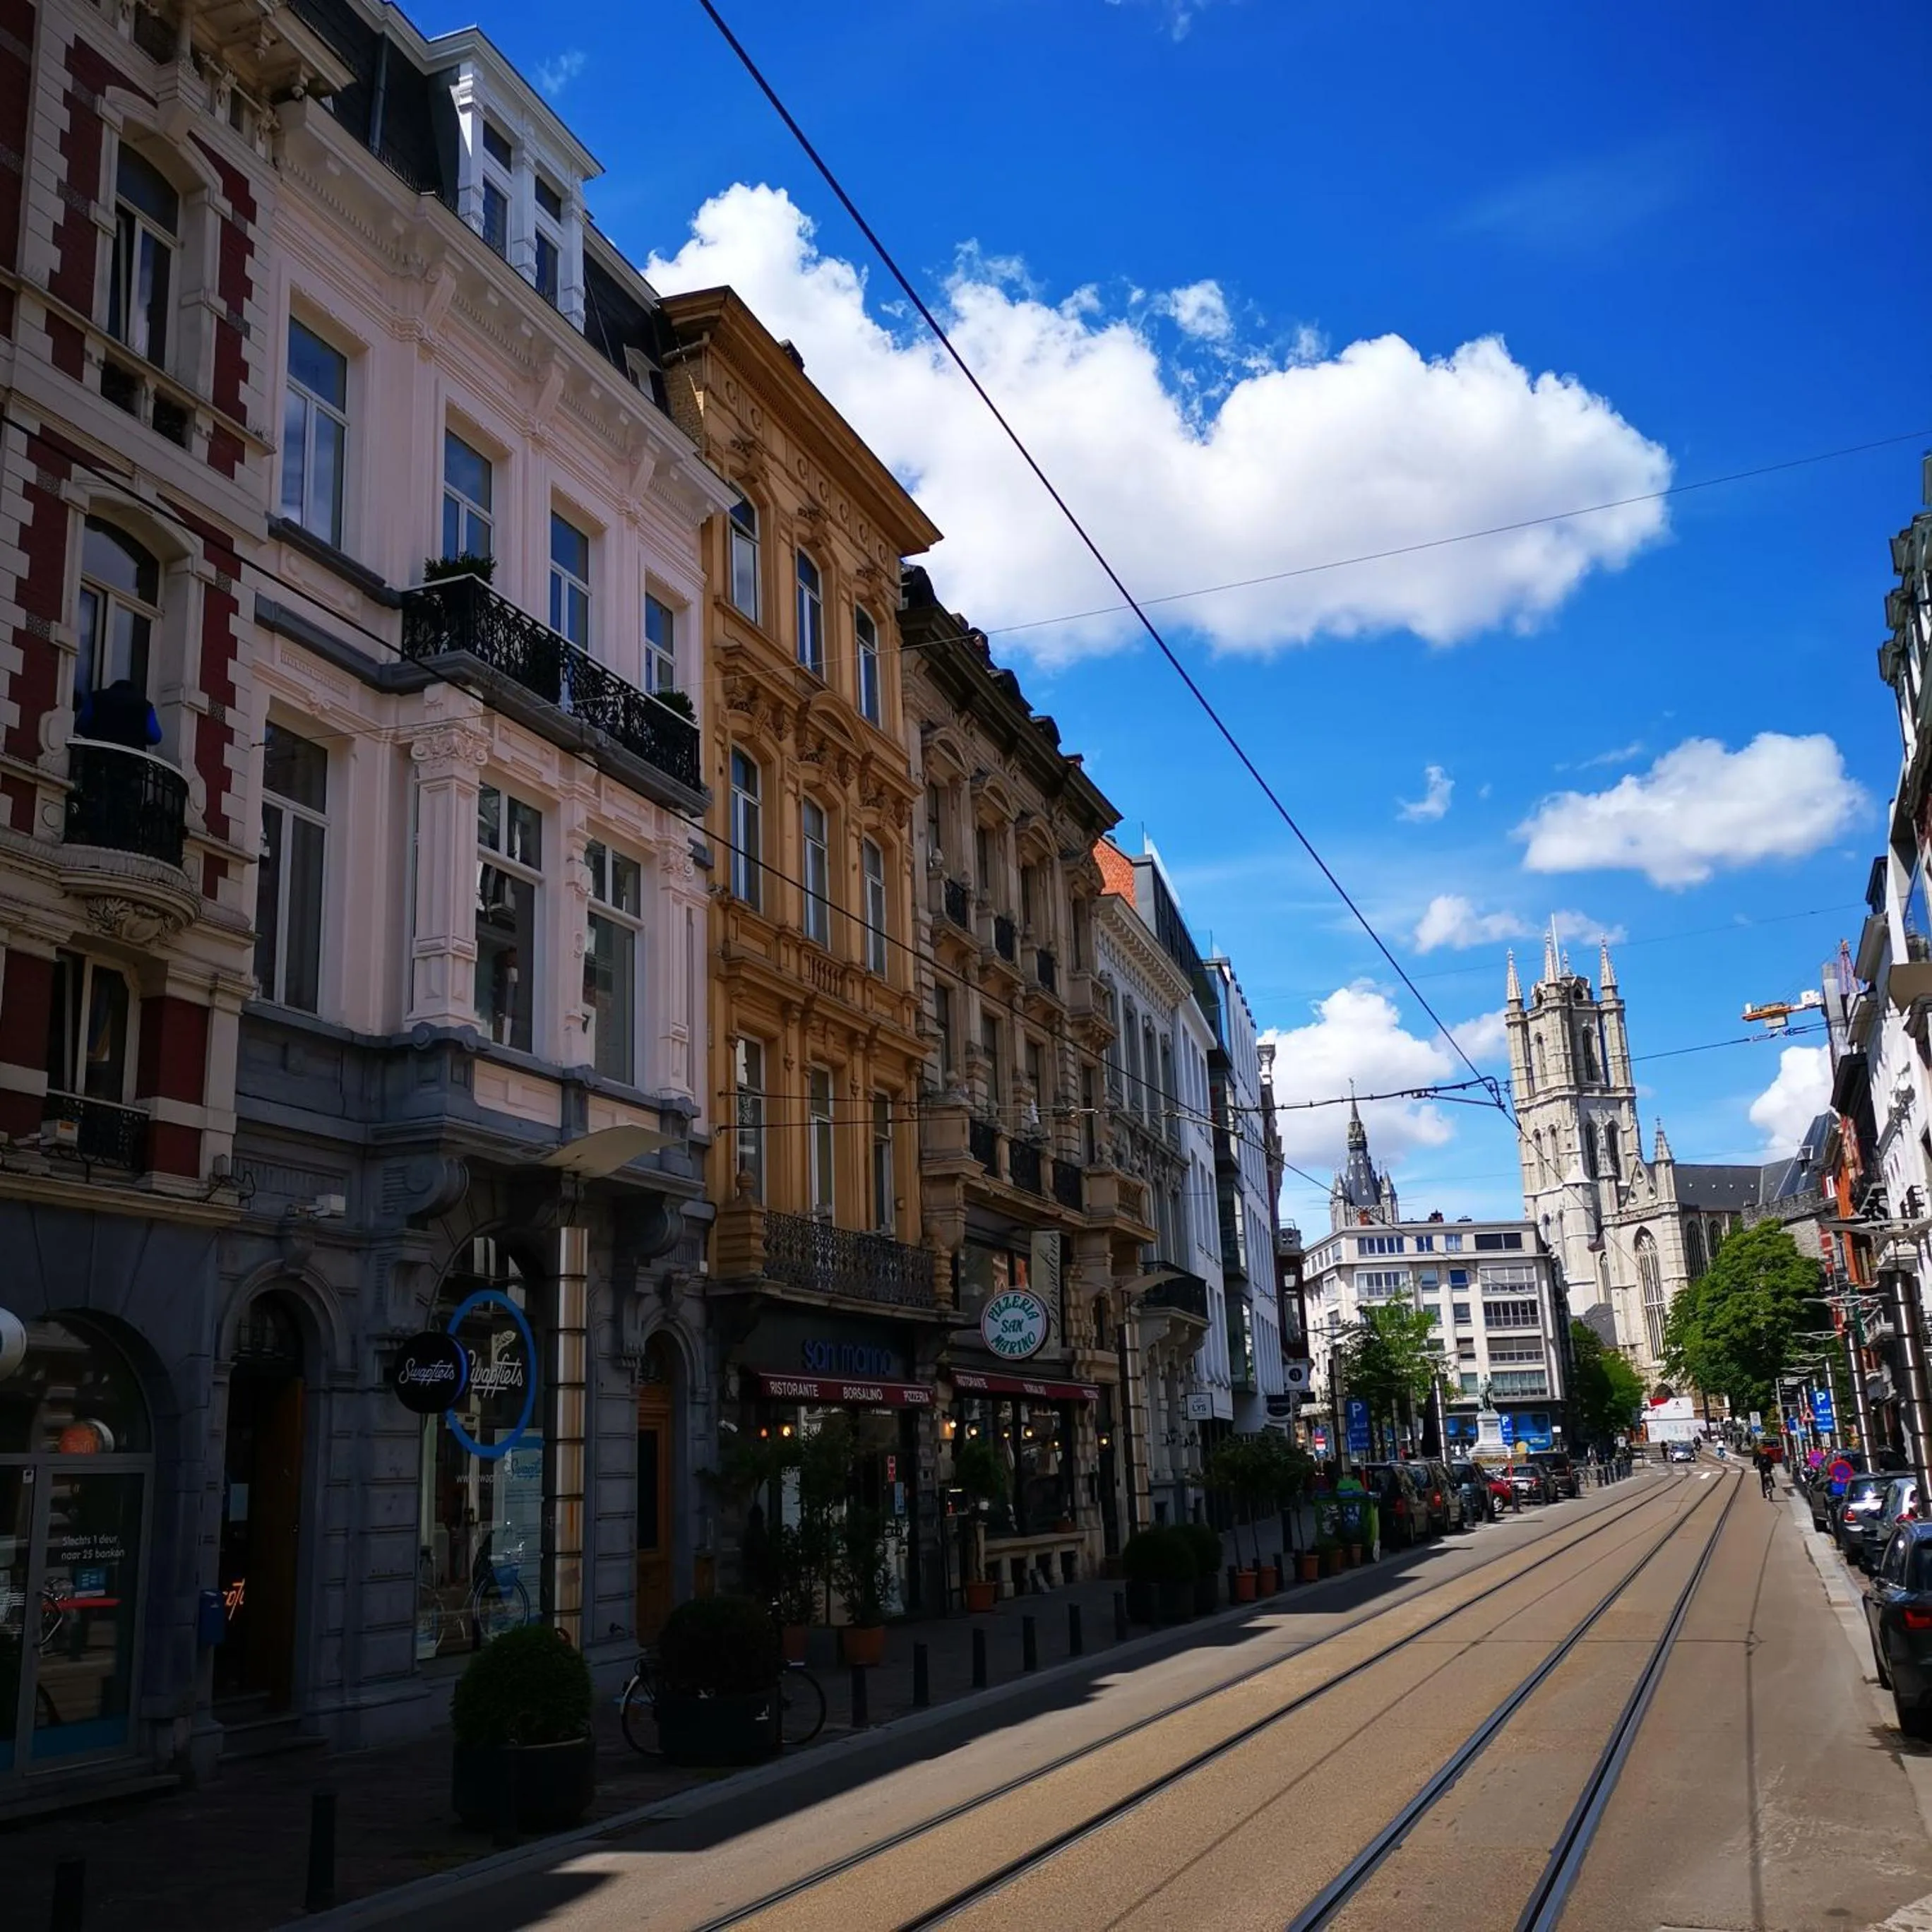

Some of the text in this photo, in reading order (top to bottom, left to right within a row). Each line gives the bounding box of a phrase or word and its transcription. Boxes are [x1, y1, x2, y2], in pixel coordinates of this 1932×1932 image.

[988, 1295, 1039, 1323] PIZZERIA
[1001, 1318, 1024, 1333] SAN
[991, 1331, 1036, 1354] MARINO
[398, 1358, 455, 1386] Swapfiets
[768, 1381, 820, 1398] RISTORANTE
[842, 1386, 883, 1401] BORSALINO
[1815, 1392, 1826, 1405] P
[1351, 1402, 1363, 1419] P
[1501, 1416, 1510, 1426] P
